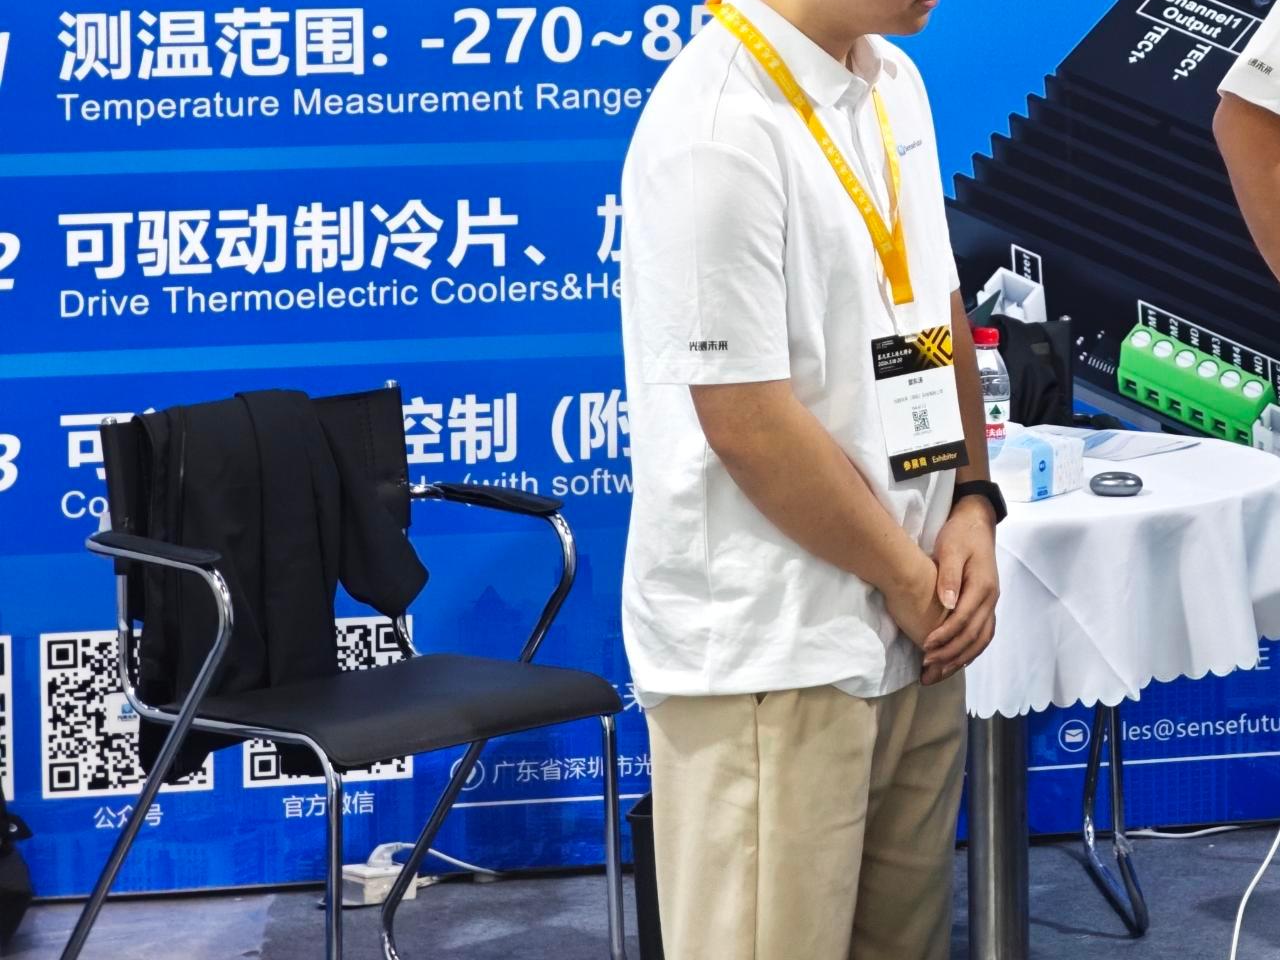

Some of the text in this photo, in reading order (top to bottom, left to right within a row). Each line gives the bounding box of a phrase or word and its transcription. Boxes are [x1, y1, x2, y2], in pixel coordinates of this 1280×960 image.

[1162, 6, 1222, 39] Output
[1128, 25, 1170, 64] TEC1+
[56, 90, 280, 126] Temperature
[293, 84, 525, 117] Measurement
[59, 288, 150, 318] Drive
[162, 277, 420, 316] Thermoelectric
[931, 452, 959, 465] Exhibitor
